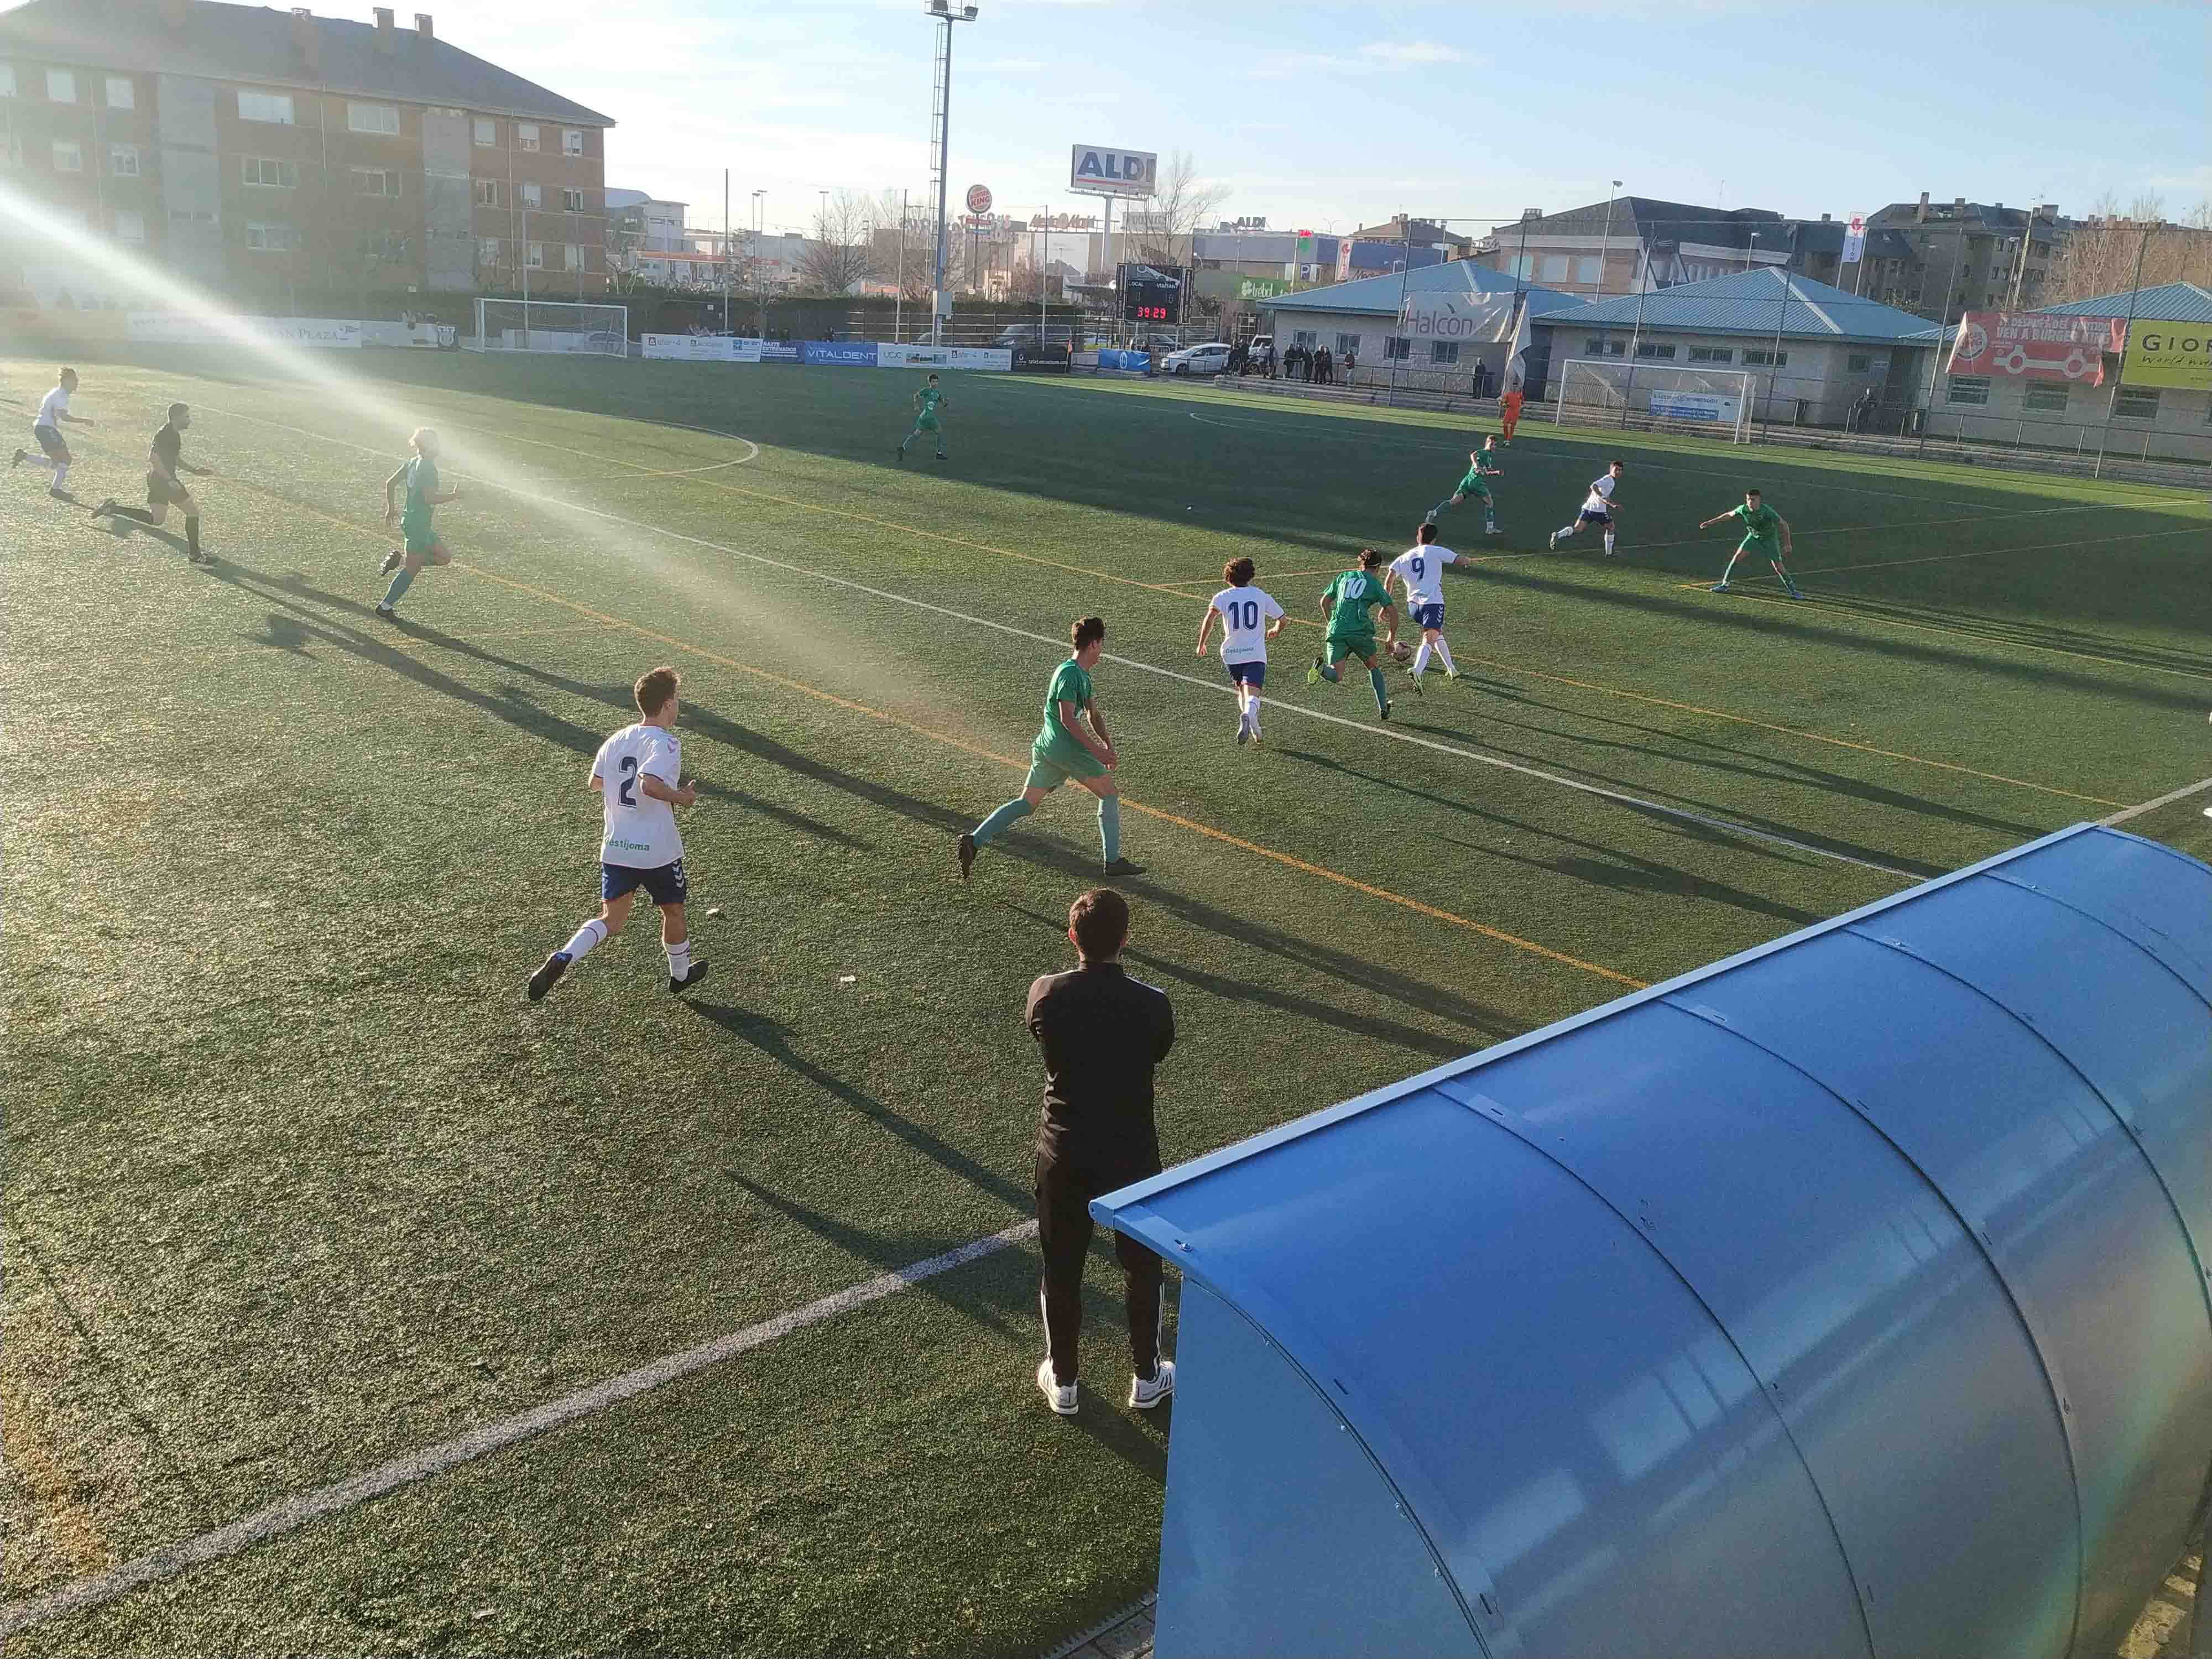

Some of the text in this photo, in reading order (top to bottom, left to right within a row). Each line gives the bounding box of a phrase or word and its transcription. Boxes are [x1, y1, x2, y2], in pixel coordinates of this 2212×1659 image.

[1077, 151, 1156, 182] ALDI
[971, 196, 991, 207] KING
[1237, 216, 1266, 227] ALDI
[1301, 265, 1310, 280] P
[807, 348, 877, 360] VITALDENT
[1411, 557, 1425, 580] 9
[1344, 577, 1367, 599] 10
[1227, 600, 1259, 630] 10
[618, 756, 638, 809] 2
